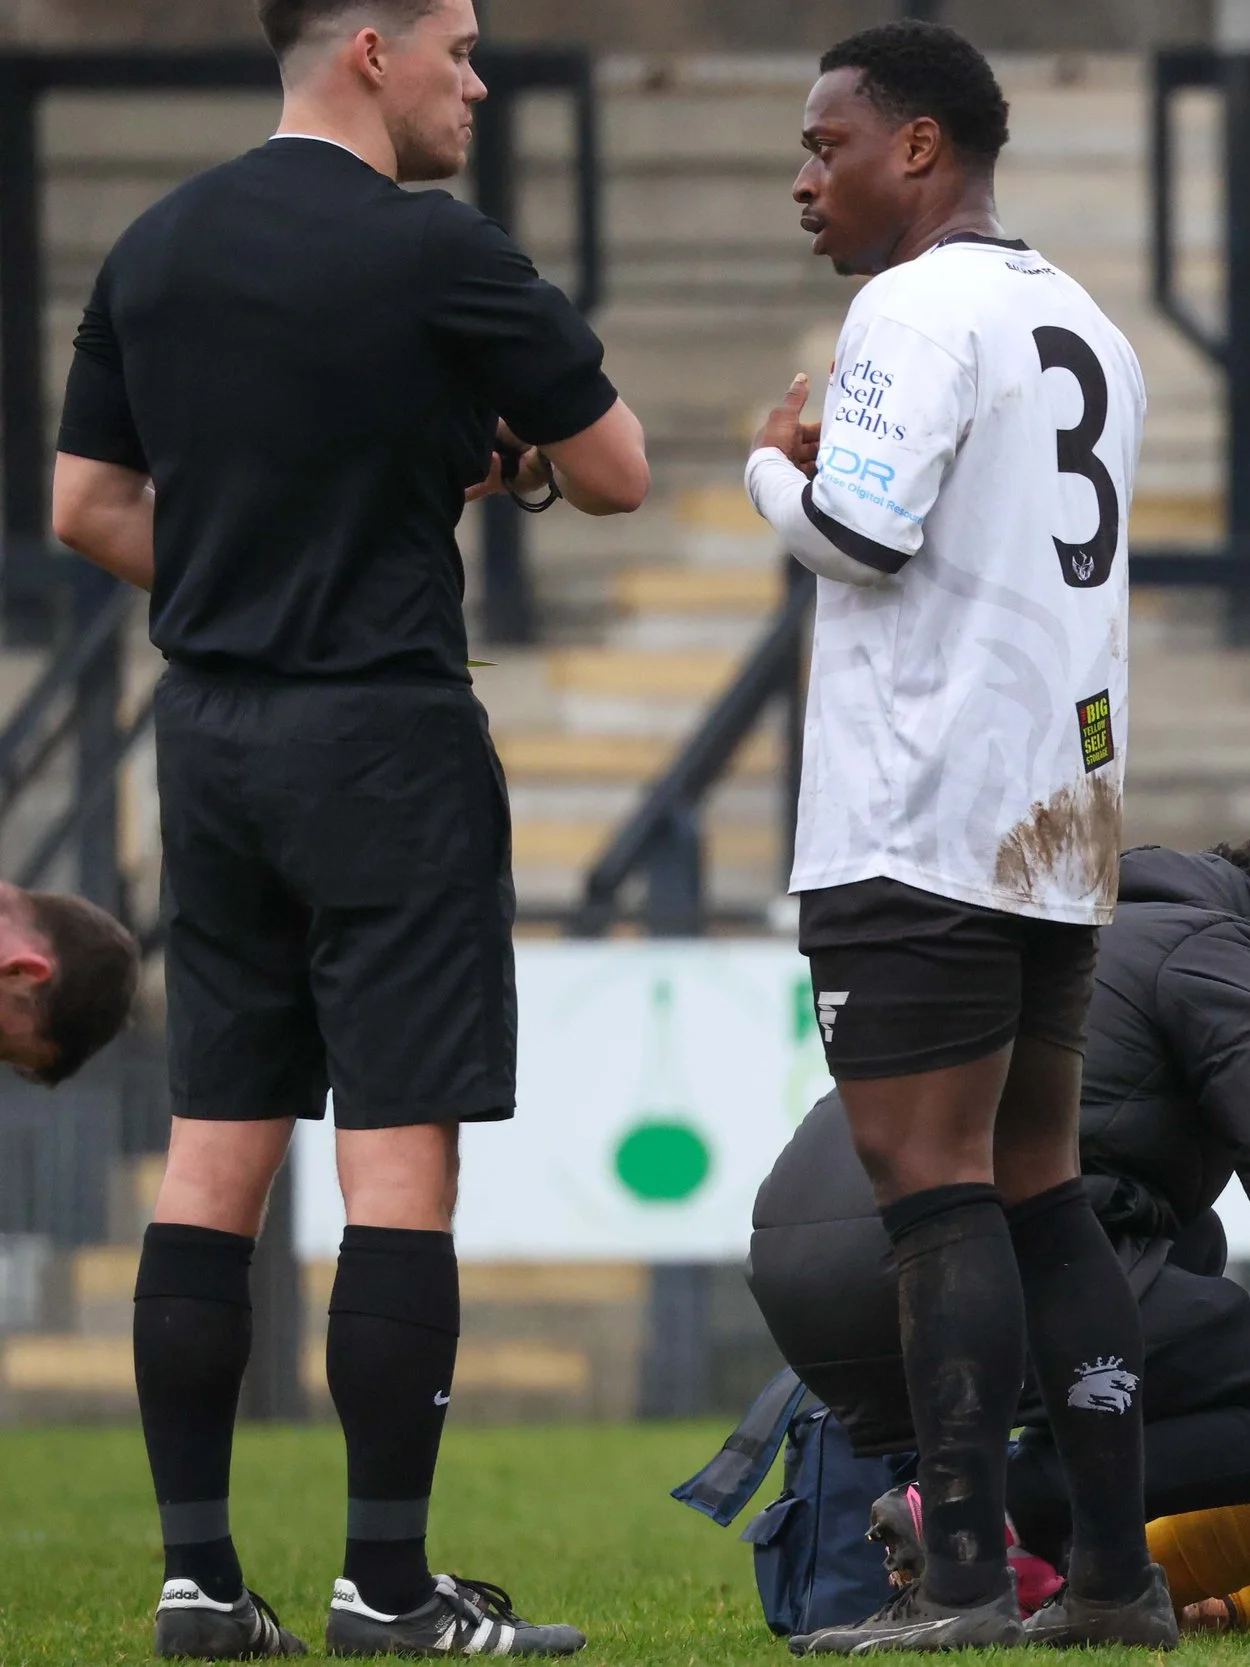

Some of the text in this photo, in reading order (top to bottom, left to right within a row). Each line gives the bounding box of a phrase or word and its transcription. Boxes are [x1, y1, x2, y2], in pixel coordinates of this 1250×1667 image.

[817, 446, 896, 492] DR
[1032, 326, 1119, 588] 3
[847, 483, 885, 507] Digital
[1086, 698, 1108, 724] BIG
[1083, 719, 1106, 738] YELLOW
[1084, 730, 1107, 754] SELF
